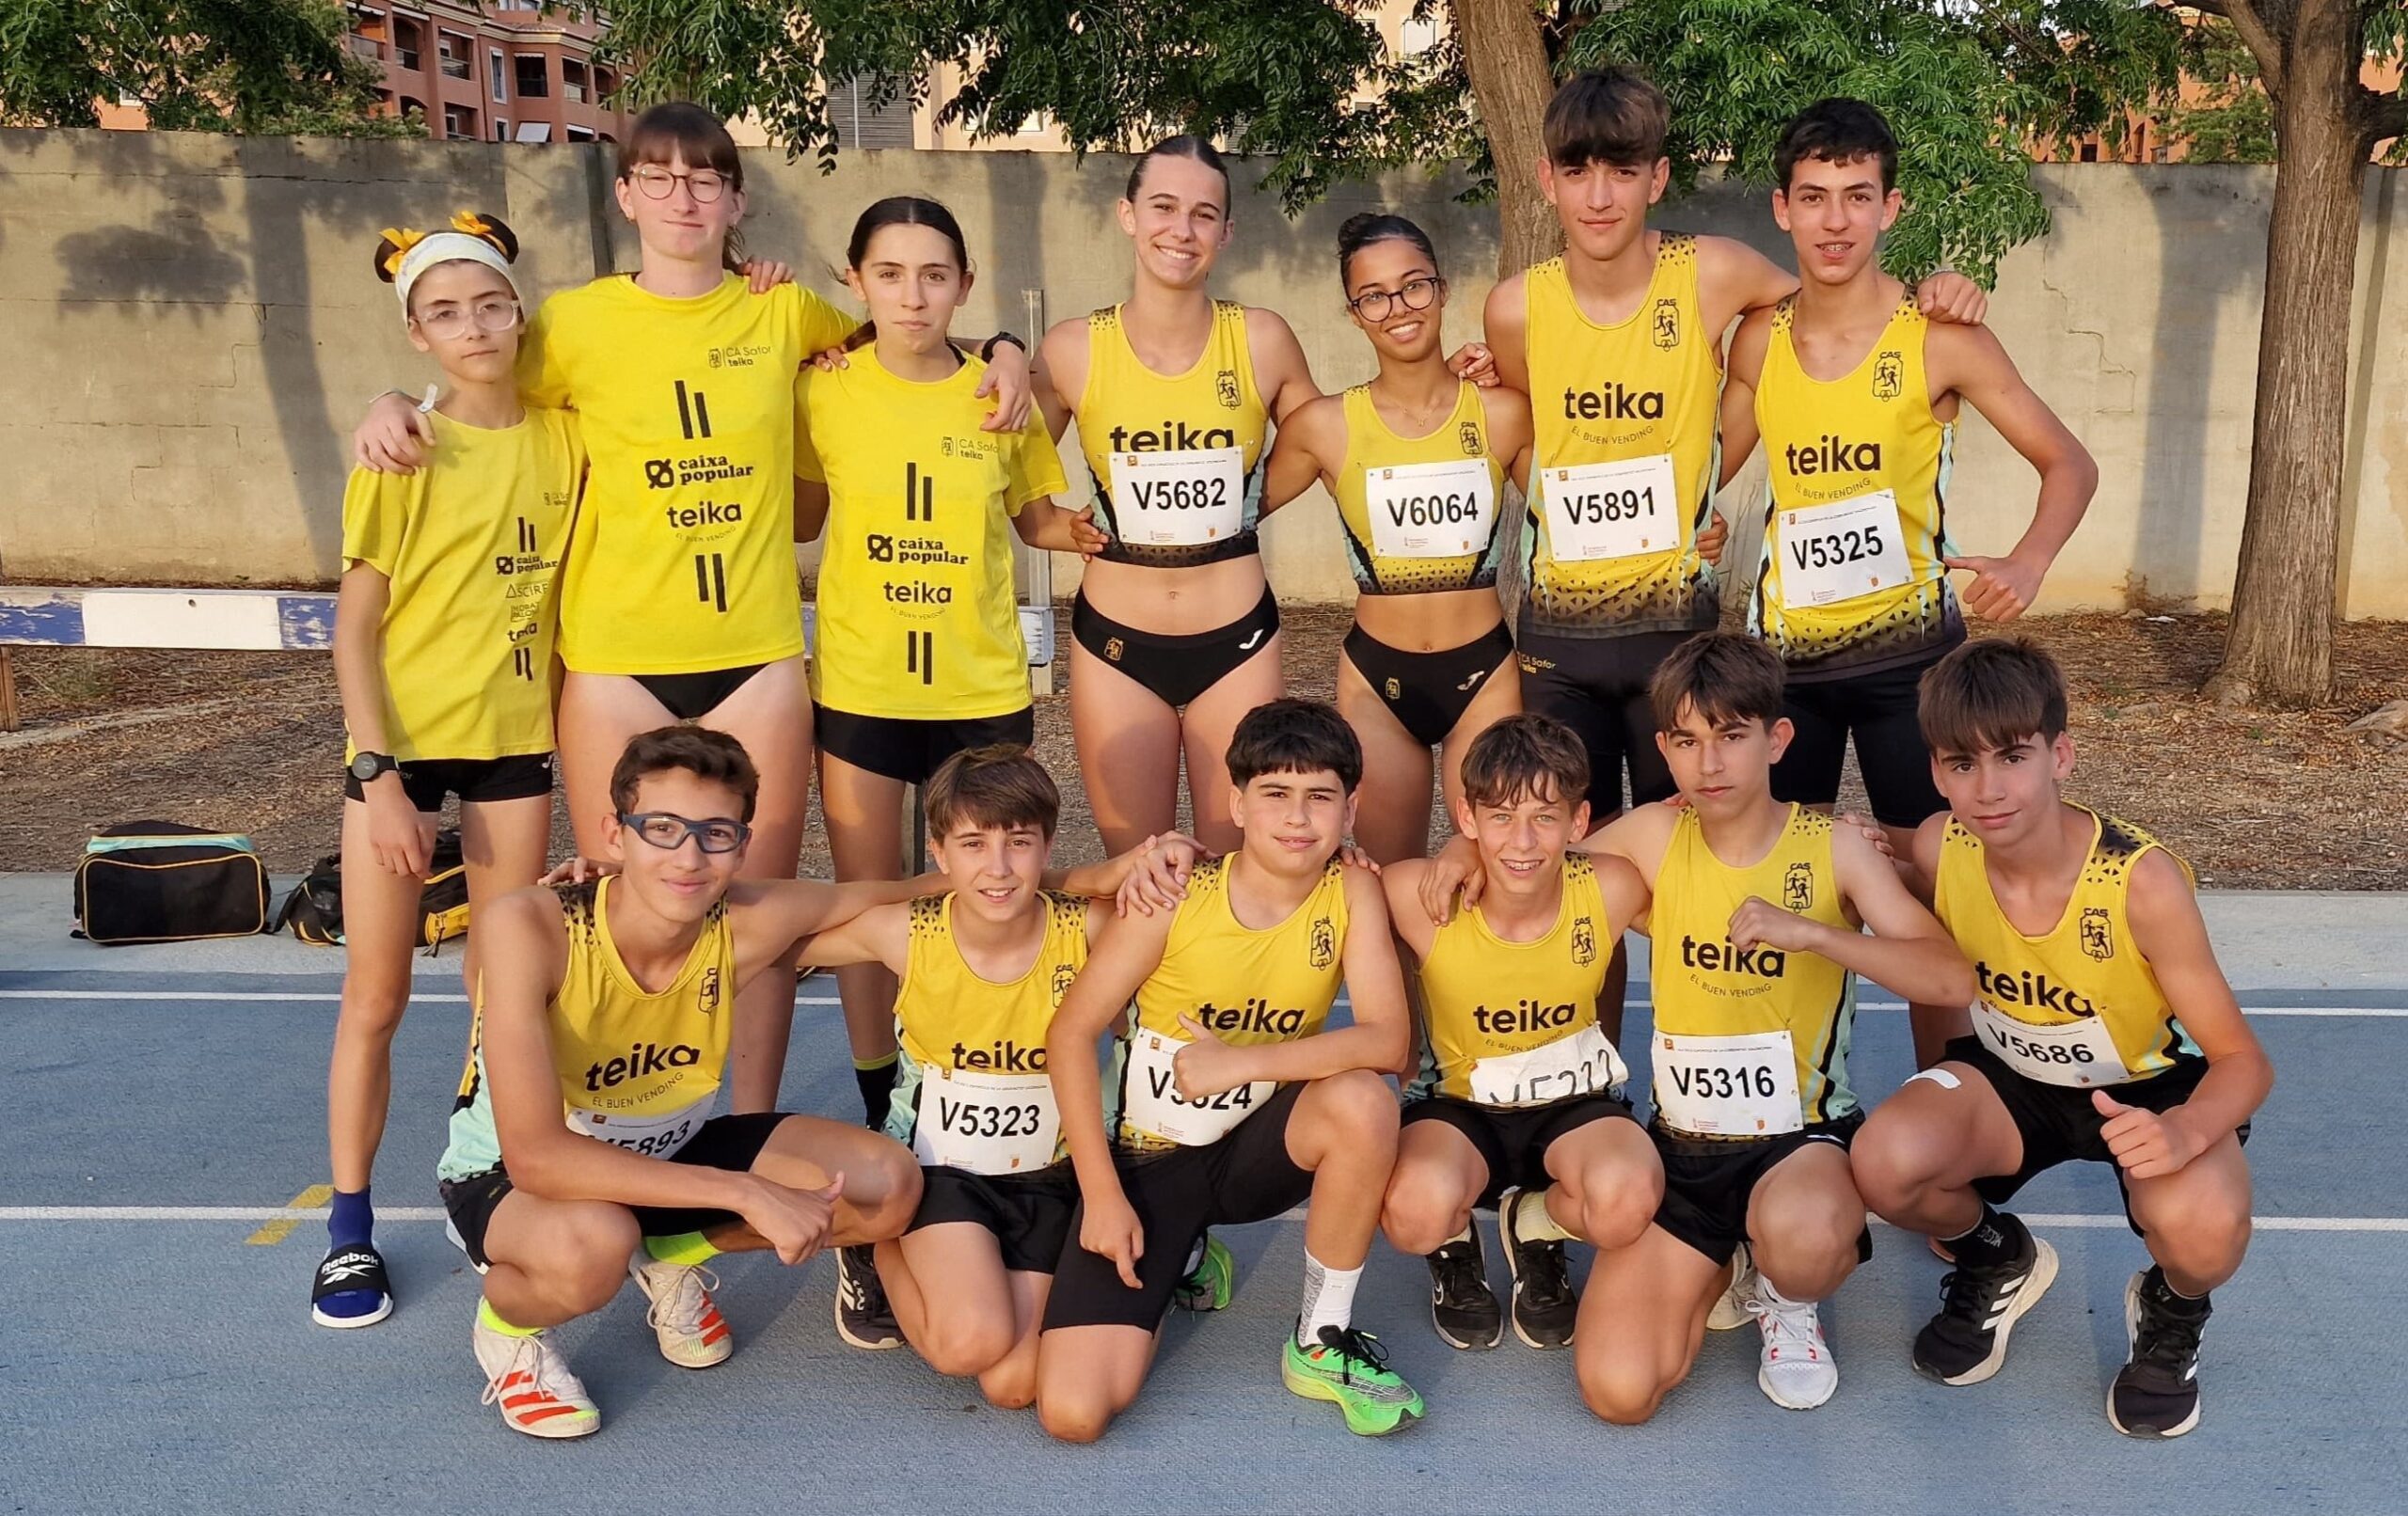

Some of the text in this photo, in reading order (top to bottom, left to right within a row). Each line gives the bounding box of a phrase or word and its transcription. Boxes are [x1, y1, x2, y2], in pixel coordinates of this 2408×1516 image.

[1656, 298, 1677, 307] CAS
[725, 345, 771, 357] CA Safor
[728, 357, 753, 367] teika
[1878, 351, 1902, 359] CAS
[1563, 381, 1664, 420] teika
[958, 438, 974, 450] CA
[1109, 420, 1235, 453] teika
[1571, 424, 1654, 444] EL BUEN VENDING
[677, 454, 728, 470] caixa
[1785, 434, 1881, 476] teika
[679, 465, 754, 485] popular
[1795, 477, 1872, 500] EL BUEN VENDING
[1131, 478, 1227, 511] V5682
[1386, 491, 1479, 528] V6064
[1563, 485, 1656, 526] V5891
[666, 500, 742, 529] teika
[897, 537, 944, 550] caixa
[898, 551, 969, 565] popular
[1791, 525, 1884, 571] V5325
[882, 579, 953, 604] teika
[1531, 656, 1557, 670] Safor
[1790, 862, 1811, 871] CAS
[2083, 908, 2109, 918] CAS
[1681, 934, 1786, 978] teika
[1689, 973, 1772, 998] EL BUEN VENDING
[1975, 960, 2096, 1019] teika
[1199, 998, 1307, 1035] teika
[1472, 999, 1576, 1034] teika
[1987, 1021, 2095, 1065] V5686
[584, 1042, 701, 1093] teika
[1670, 1065, 1776, 1098] V5316
[593, 1071, 685, 1109] EL BUEN VENDING
[1148, 1066, 1253, 1111] V24
[940, 1096, 1040, 1138] V5323
[588, 1119, 691, 1156] 893
[321, 1252, 379, 1274] Reebok
